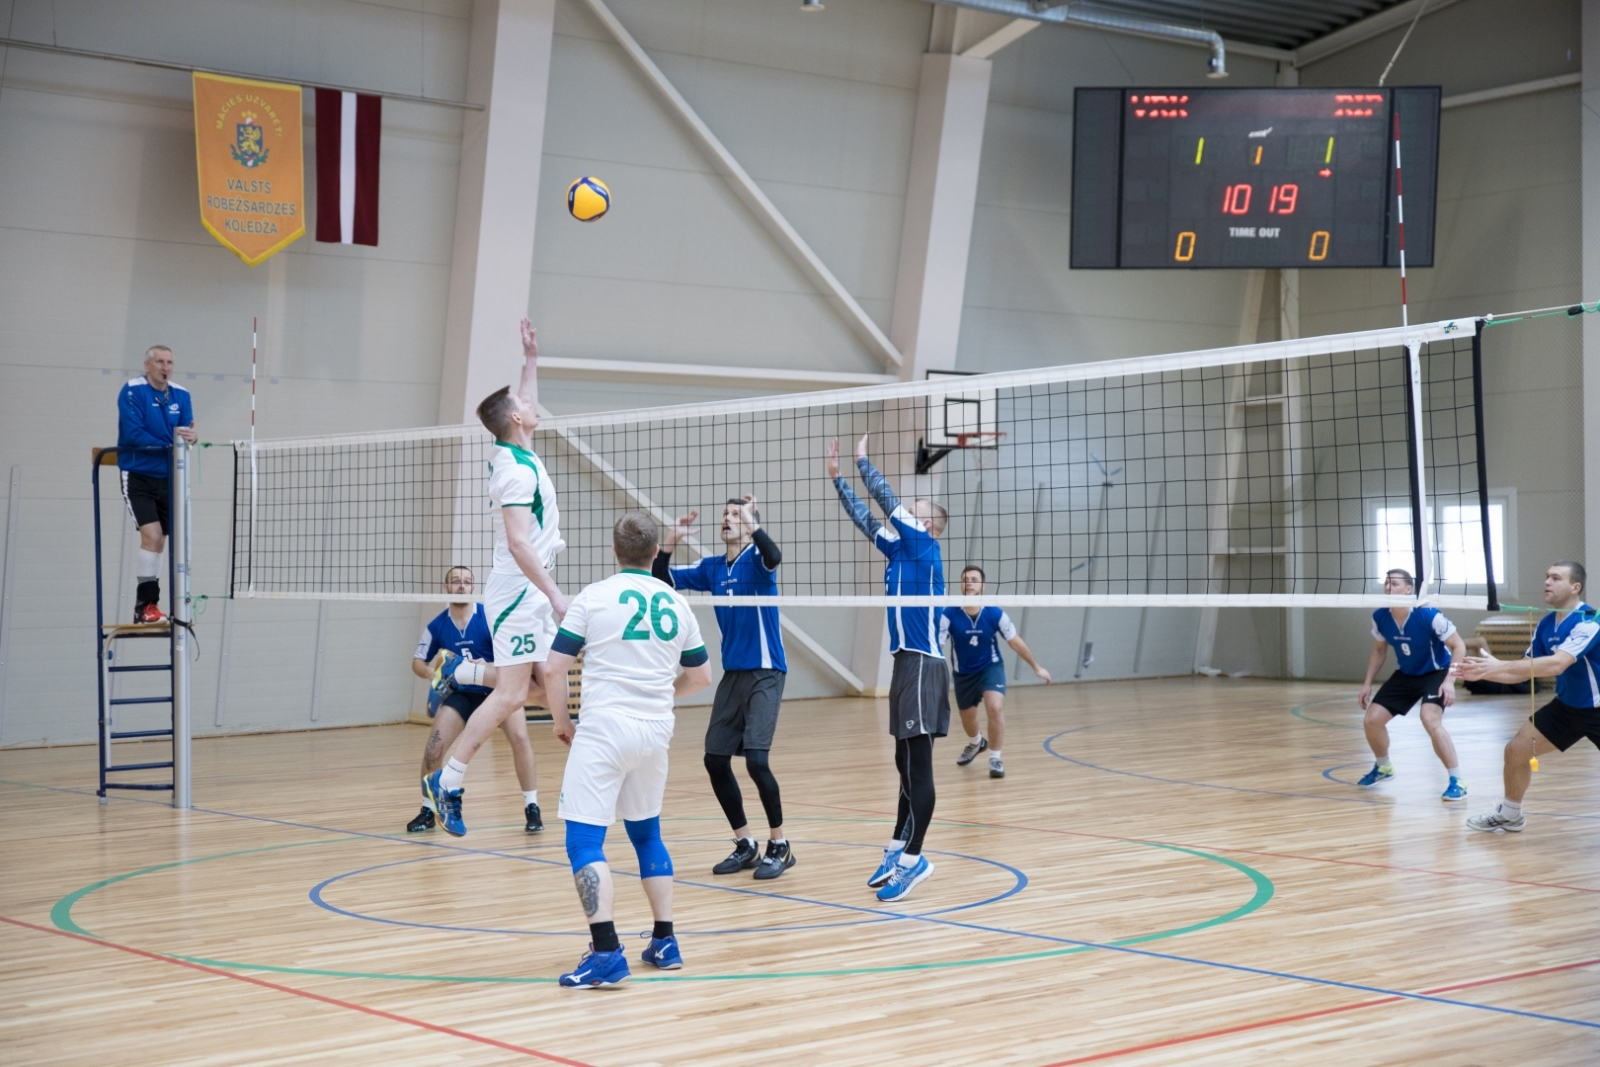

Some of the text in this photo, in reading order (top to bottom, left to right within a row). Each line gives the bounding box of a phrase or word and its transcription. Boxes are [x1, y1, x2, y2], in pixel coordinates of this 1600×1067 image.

[1195, 136, 1205, 165] 1
[1254, 145, 1263, 165] 1
[1325, 136, 1334, 164] 1
[226, 177, 272, 194] VALSTS
[207, 196, 296, 216] ROBEŽSARDZES
[1222, 183, 1299, 215] 10 19
[1228, 226, 1281, 238] TIME OUT
[1174, 231, 1196, 262] 0
[1308, 230, 1330, 261] 0
[618, 588, 679, 642] 26
[510, 633, 536, 657] 25
[969, 635, 979, 647] 4
[1401, 642, 1411, 657] 9
[461, 647, 473, 661] 5
